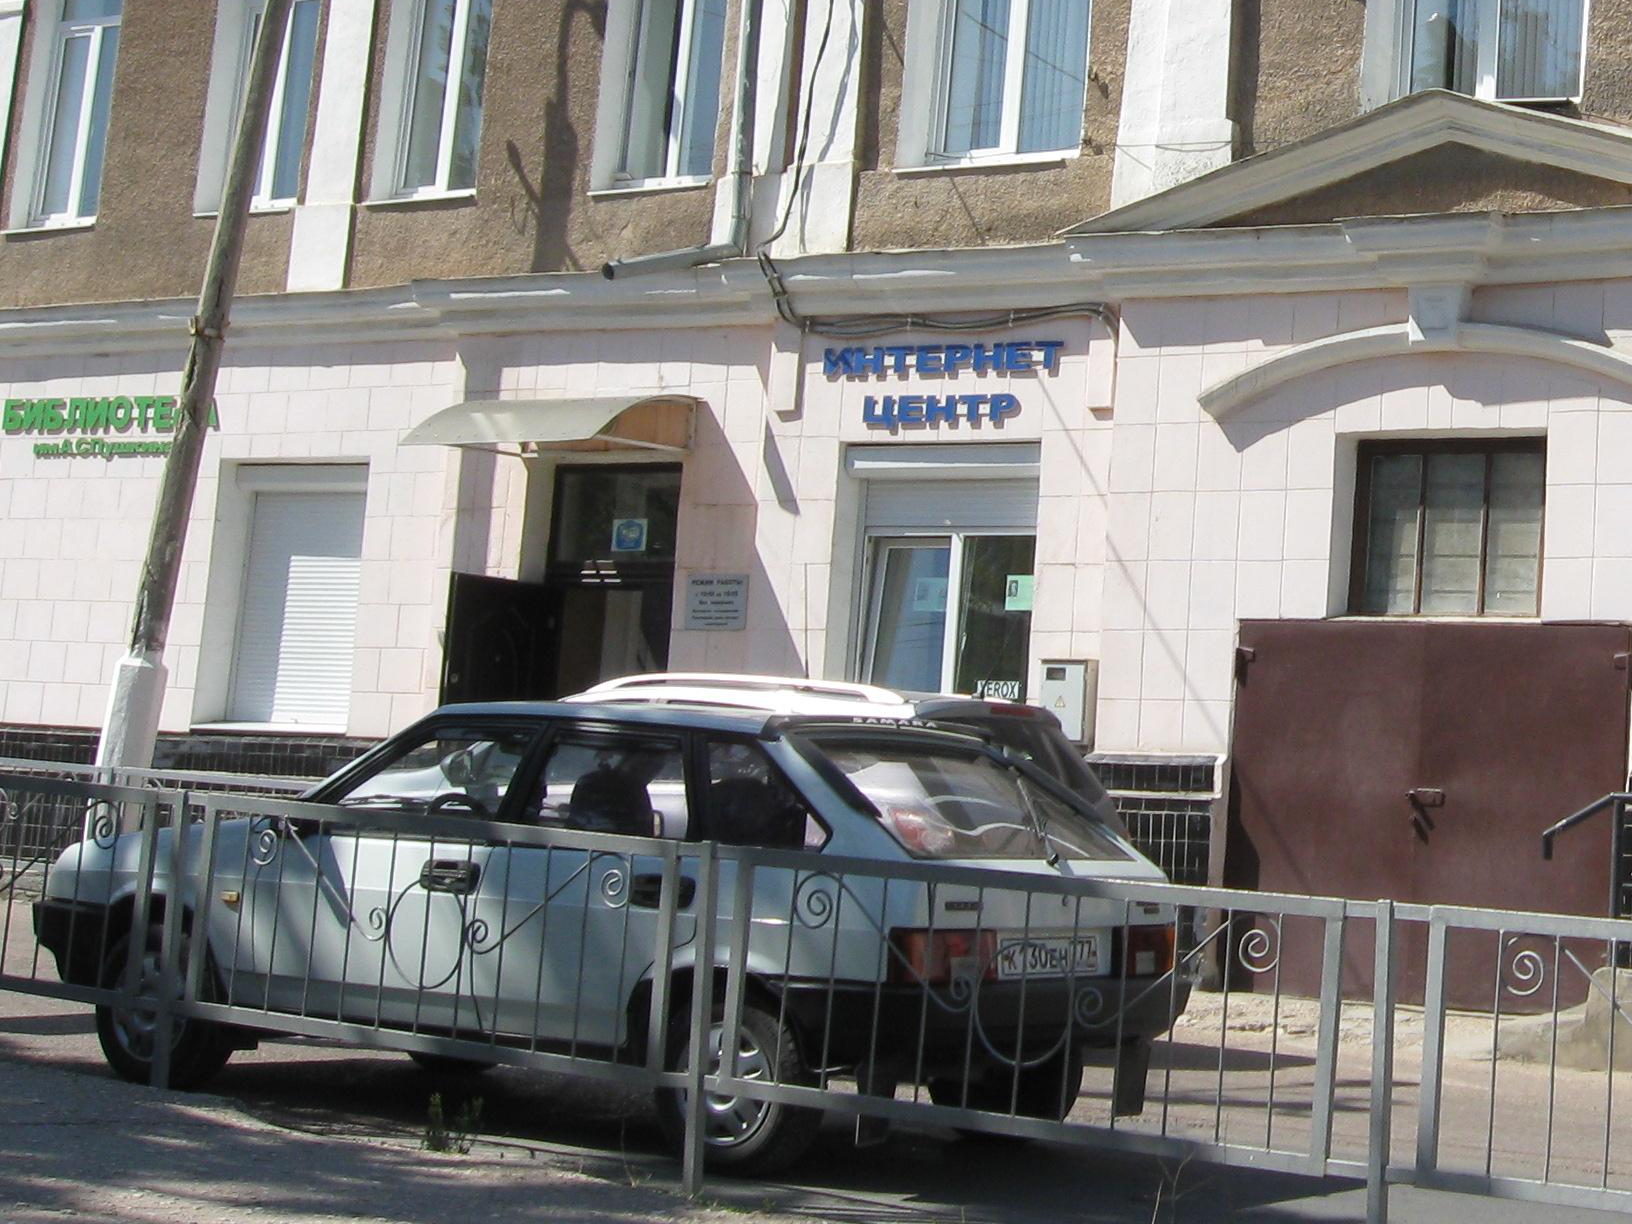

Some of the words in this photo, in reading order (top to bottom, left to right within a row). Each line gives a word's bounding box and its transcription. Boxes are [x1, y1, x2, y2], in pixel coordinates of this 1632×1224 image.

[823, 341, 1065, 379] ИНТЕРНЕТ
[3, 395, 221, 435] БИБЛИОТЕ
[863, 392, 1021, 433] ЦЕНТР
